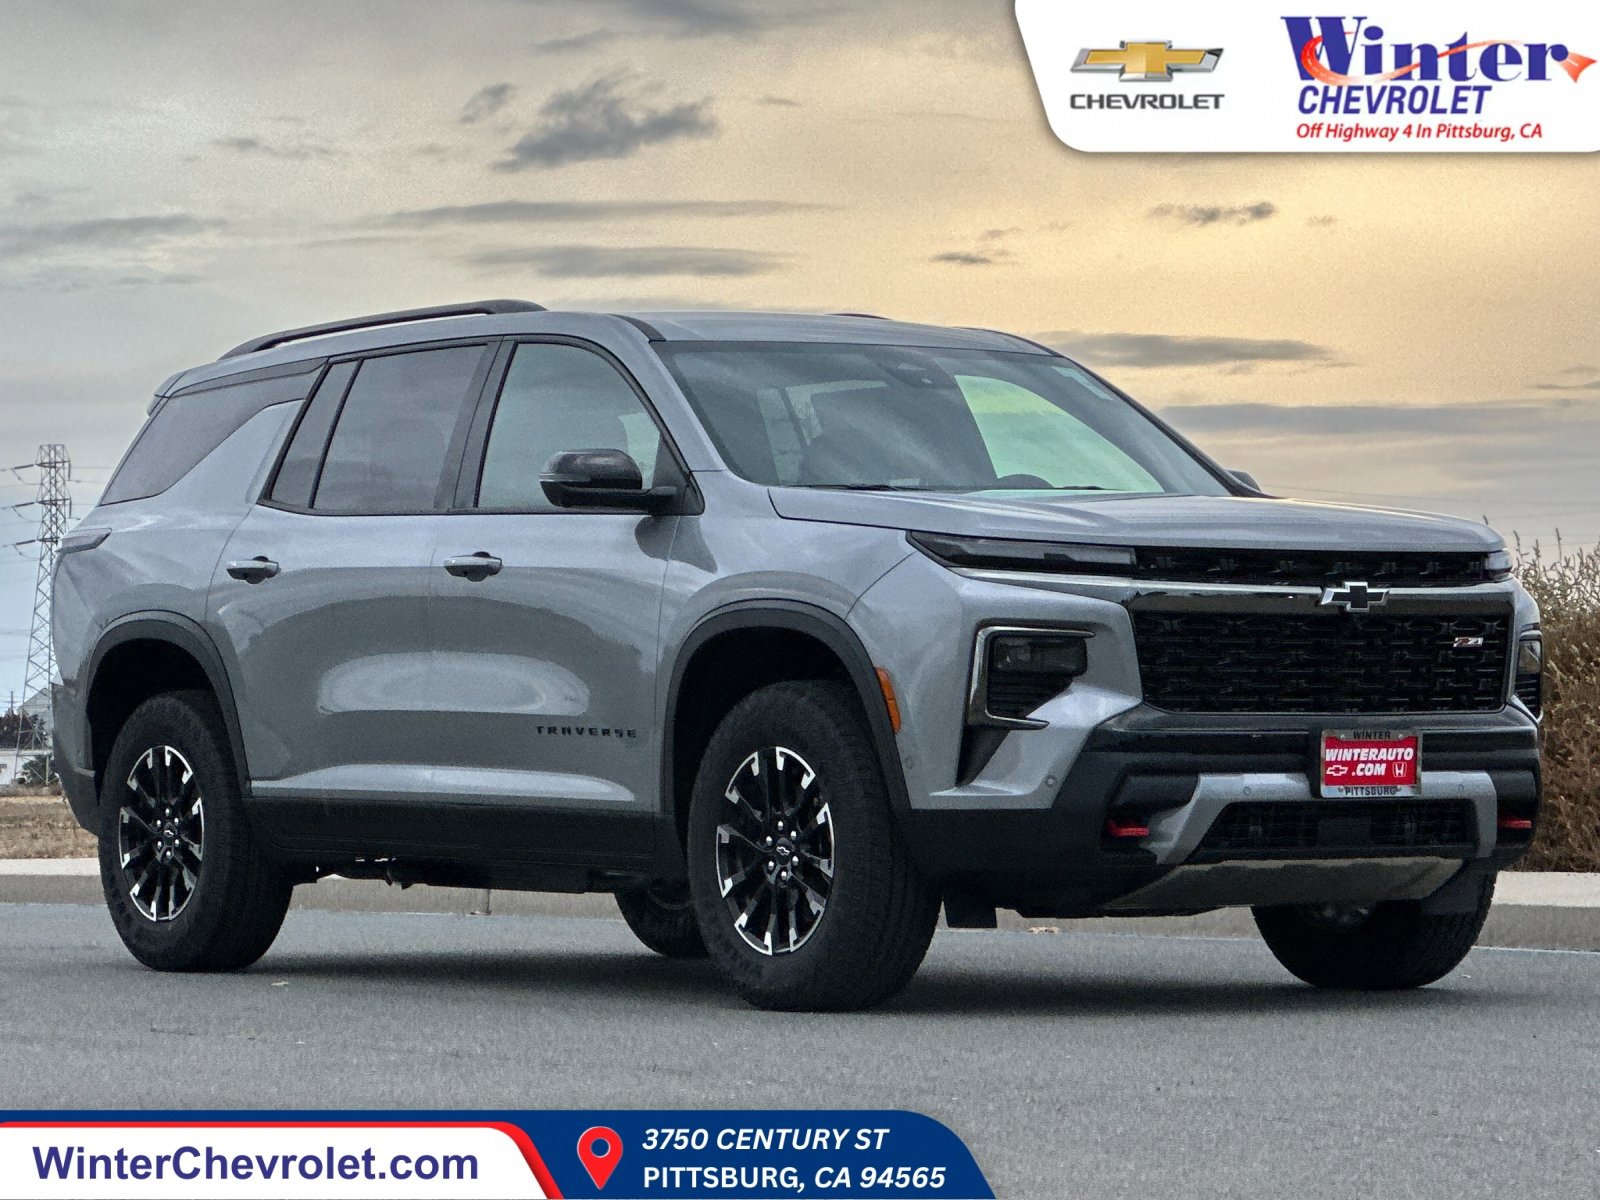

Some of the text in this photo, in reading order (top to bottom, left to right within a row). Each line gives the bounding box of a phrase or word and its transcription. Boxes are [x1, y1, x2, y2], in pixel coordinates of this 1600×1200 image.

[536, 726, 637, 738] TRAVERSE
[1353, 730, 1391, 740] WINTER
[1325, 748, 1414, 761] WINTERAUTO
[1351, 763, 1386, 776] .COM
[1345, 787, 1396, 795] PITTSBURG
